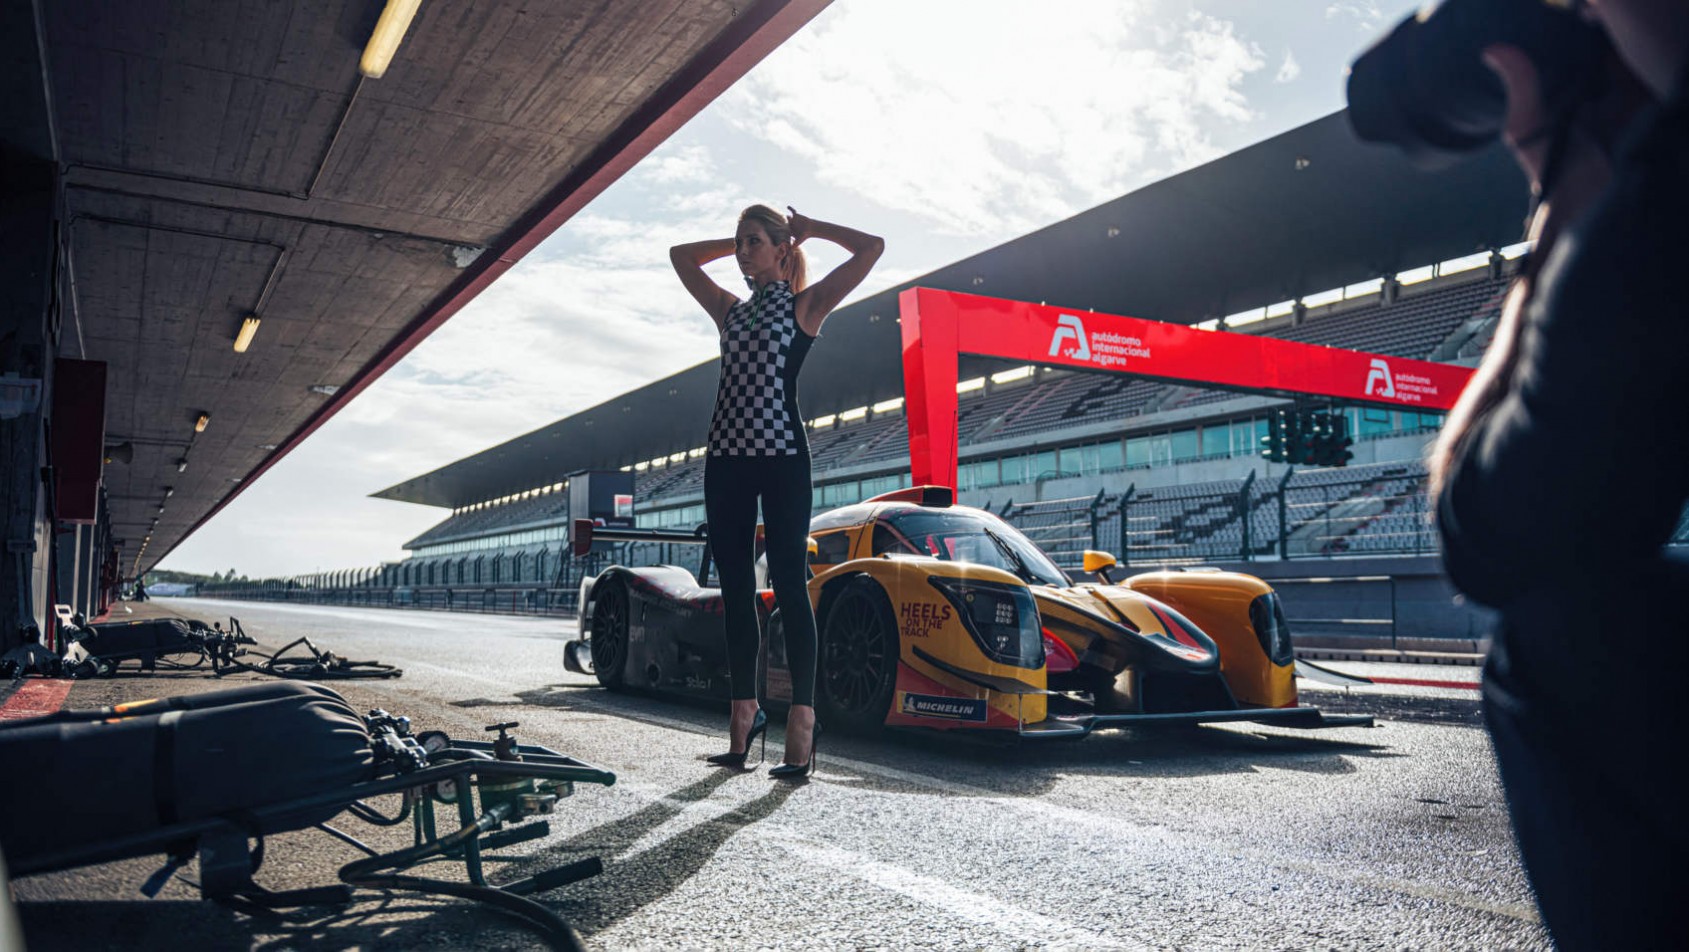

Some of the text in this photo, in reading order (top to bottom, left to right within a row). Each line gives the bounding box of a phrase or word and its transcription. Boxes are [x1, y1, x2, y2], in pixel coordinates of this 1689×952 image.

[1092, 332, 1141, 346] autódromo
[1092, 342, 1150, 358] internacional
[1092, 353, 1126, 365] algarve
[901, 602, 951, 620] HEELS
[906, 619, 942, 629] ON THE
[901, 627, 929, 637] TRACK
[917, 702, 974, 714] MICHELIN
